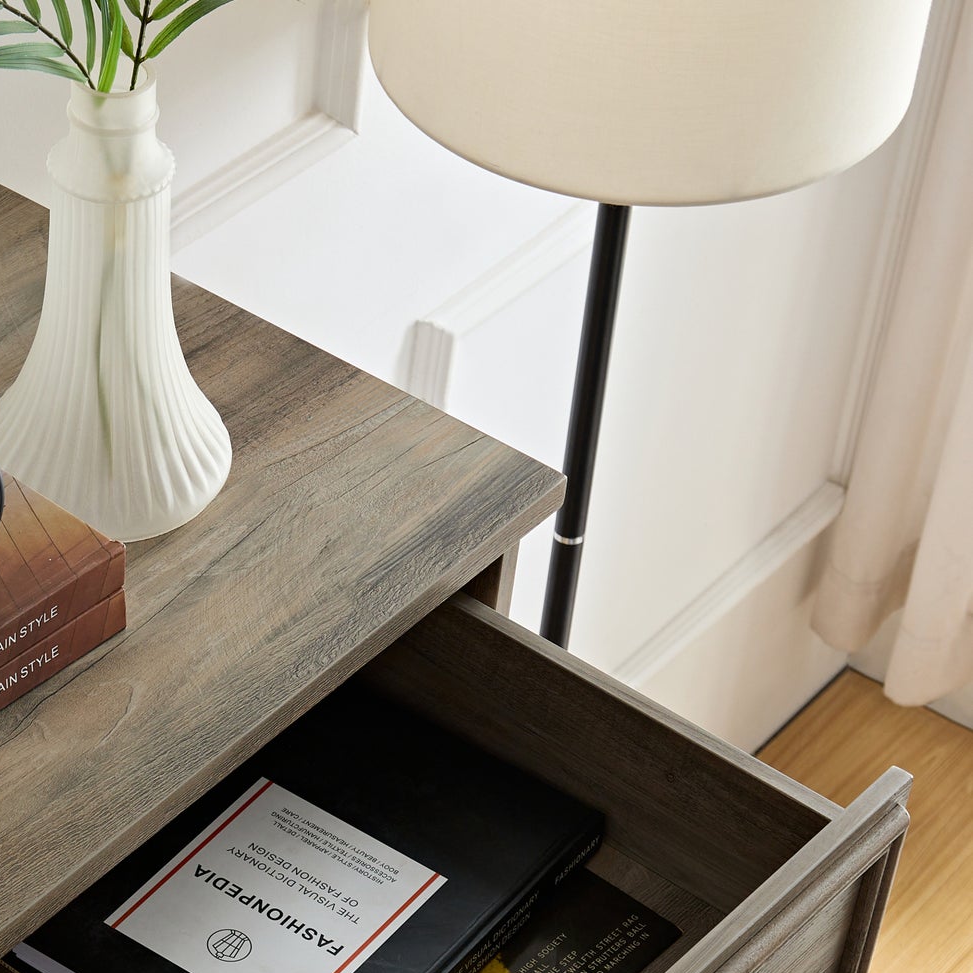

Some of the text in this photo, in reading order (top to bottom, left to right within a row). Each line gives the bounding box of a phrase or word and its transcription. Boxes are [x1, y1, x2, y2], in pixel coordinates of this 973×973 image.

[19, 605, 58, 638] STYLE
[20, 645, 59, 679] STYLE
[227, 846, 360, 925] THE VISUAL DICTIONARY
[247, 842, 359, 908] OF FASHION DESIGN
[193, 863, 345, 956] FASHIONPEDIA
[595, 927, 624, 951] STREET
[621, 914, 639, 928] RAG
[627, 923, 647, 938] BALL
[519, 958, 538, 973] HIGH
[537, 932, 567, 959] SOCIETY
[559, 950, 578, 968] STEP
[604, 940, 641, 971] MARCHING
